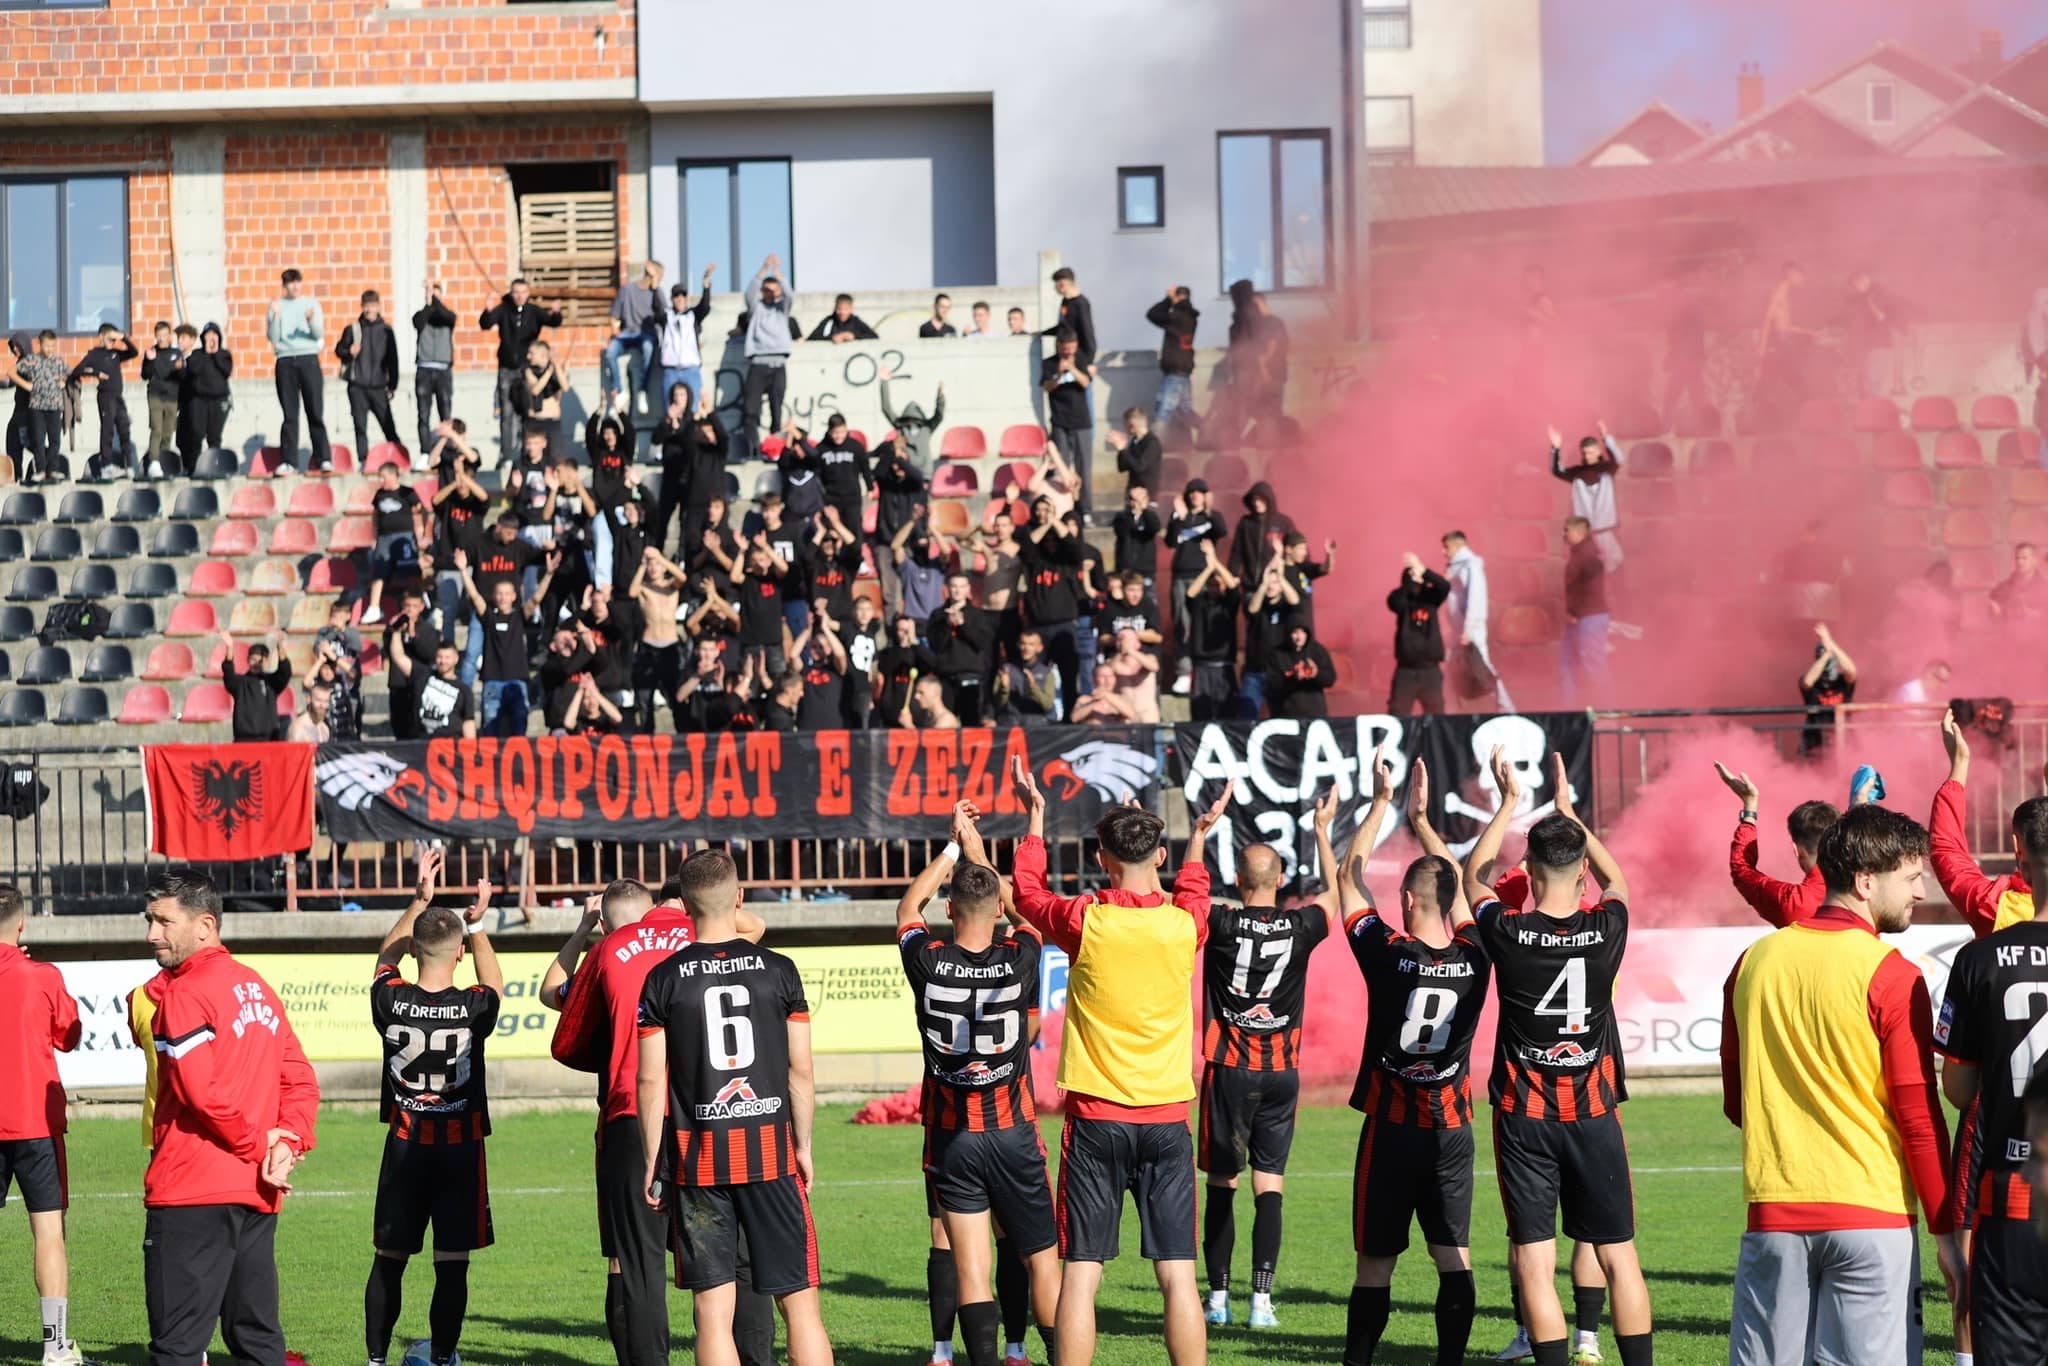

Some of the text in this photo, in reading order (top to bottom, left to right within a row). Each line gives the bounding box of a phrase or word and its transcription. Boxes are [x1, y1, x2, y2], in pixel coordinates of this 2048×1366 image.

[1184, 713, 1408, 806] ACAB
[425, 726, 1029, 833] SHQIPONJAT E ZEZA
[615, 937, 692, 963] DRENIC
[1518, 929, 1604, 947] KF DRENICA
[679, 955, 766, 978] KF DRENICA
[1227, 935, 1294, 999] 17
[1398, 958, 1475, 978] KF DRENICA
[1996, 945, 2025, 967] KF
[936, 960, 1014, 979] KF DRENICA
[280, 980, 372, 995] Raiffeise
[1534, 956, 1592, 1035] 4
[392, 1000, 469, 1020] KF DRENICA
[924, 981, 1022, 1056] 55
[1400, 986, 1458, 1055] 8
[704, 984, 756, 1071] 6
[385, 1024, 473, 1092] 23
[731, 1097, 782, 1118] GROUP
